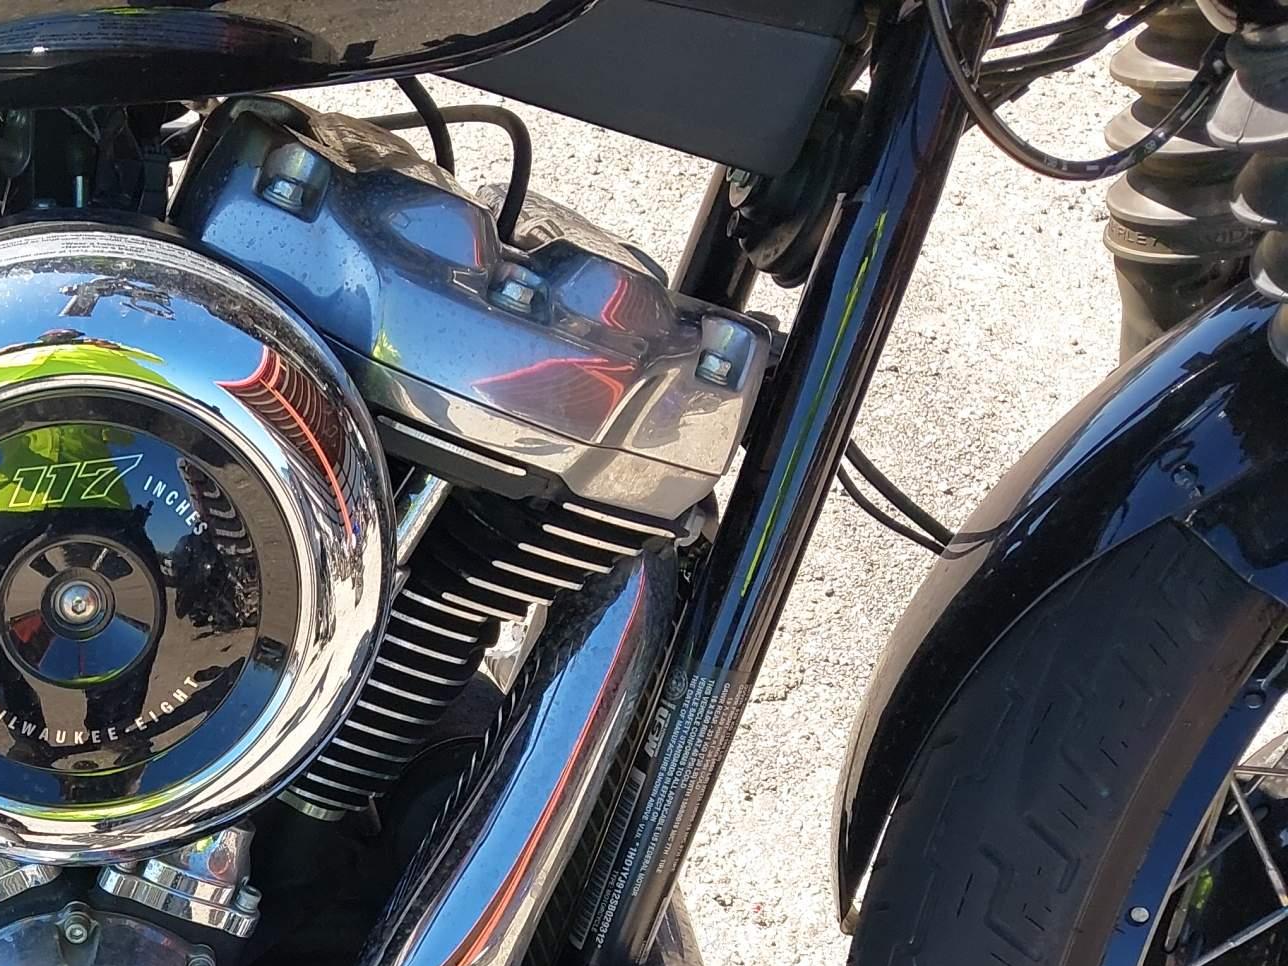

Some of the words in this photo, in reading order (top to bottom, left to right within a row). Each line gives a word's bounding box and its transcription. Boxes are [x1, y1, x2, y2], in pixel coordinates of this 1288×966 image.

[8, 453, 144, 508] 117
[143, 475, 209, 537] INCHES
[688, 673, 699, 689] THE
[690, 675, 707, 707] VEHICLE
[703, 677, 715, 696] THIS
[681, 687, 694, 709] DATE
[692, 694, 709, 727] VEHICLE
[677, 707, 687, 720] OF
[681, 706, 696, 734] SAFETY
[659, 718, 683, 772] MANUFACTURE
[665, 733, 687, 777] STANDARDS
[678, 725, 698, 767] CONFORMS
[693, 737, 703, 748] AT
[662, 775, 671, 785] IN
[669, 775, 680, 790] ALL
[674, 765, 684, 777] TO
[678, 768, 691, 790] COLD
[649, 770, 664, 798] SHOWN
[640, 796, 655, 821] ABOVE
[653, 784, 668, 810] EFFECT
[649, 810, 658, 823] ON
[654, 789, 675, 832] APPLICABLE
[650, 830, 660, 843] US
[639, 841, 656, 873] FEDERAL
[630, 872, 644, 898] MOTOR
